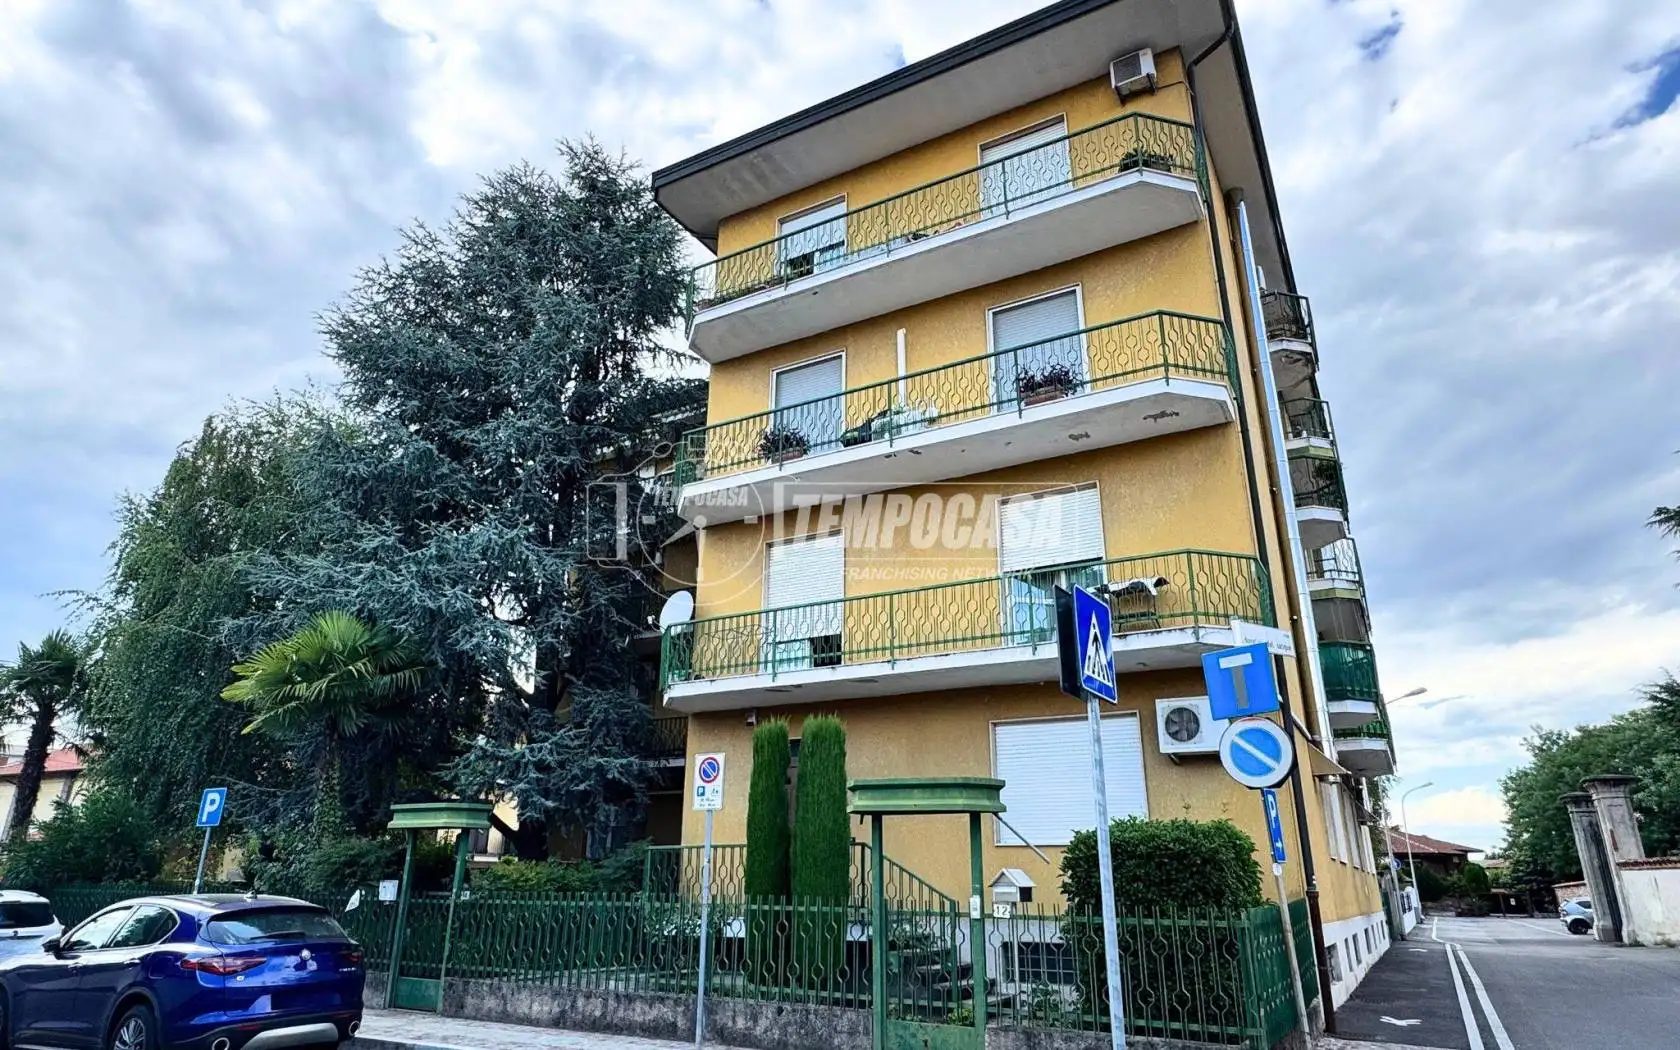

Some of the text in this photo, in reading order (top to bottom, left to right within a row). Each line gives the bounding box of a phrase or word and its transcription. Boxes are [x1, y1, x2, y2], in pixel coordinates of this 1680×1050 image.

[202, 792, 220, 822] P
[1267, 794, 1276, 828] P
[996, 905, 1008, 916] 12
